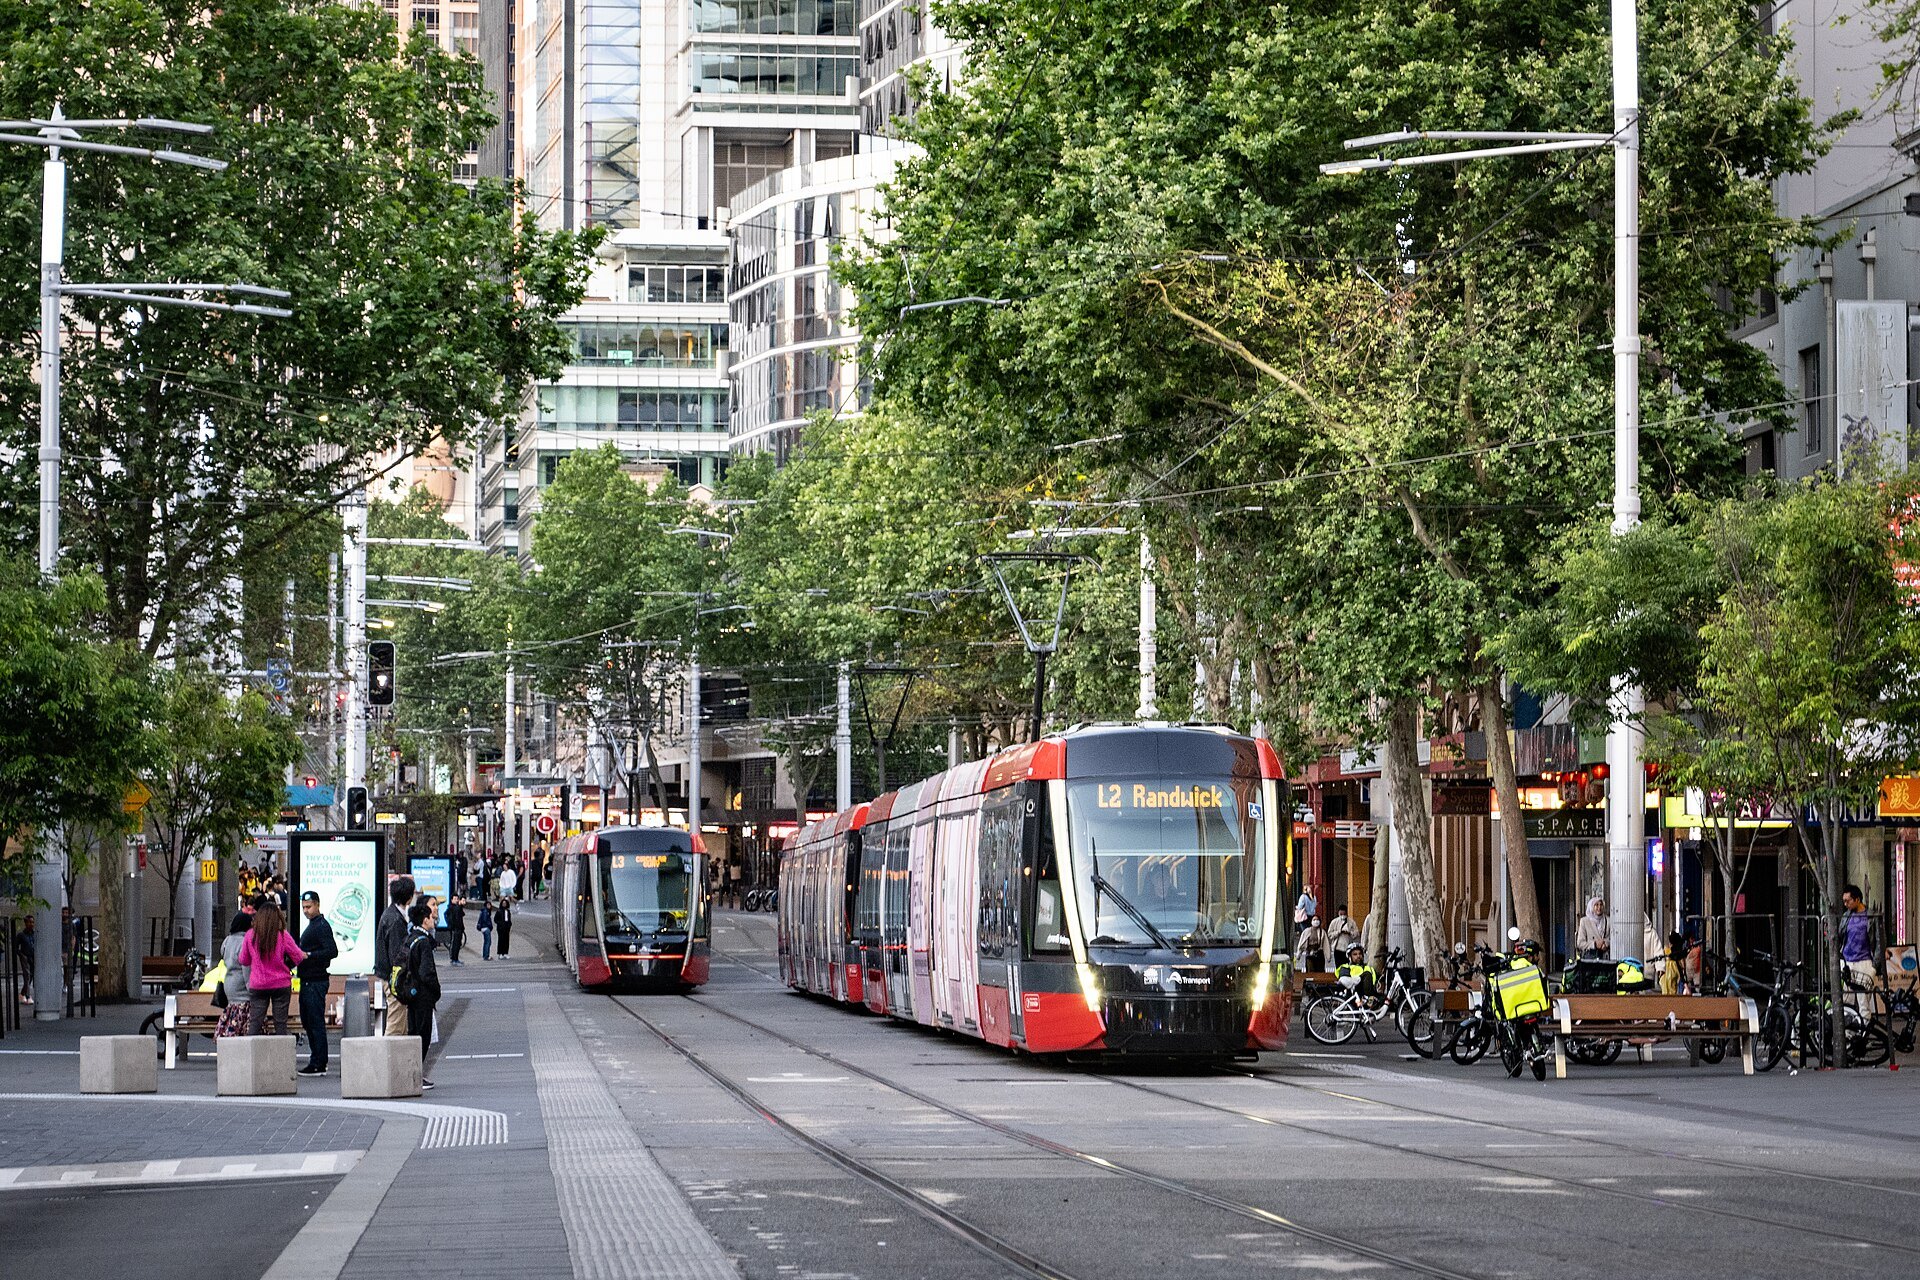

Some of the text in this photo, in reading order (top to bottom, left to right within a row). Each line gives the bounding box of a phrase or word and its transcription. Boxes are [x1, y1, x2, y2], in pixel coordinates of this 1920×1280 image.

[1098, 784, 1223, 808] L2 Randwick
[542, 818, 550, 830] L
[1295, 826, 1336, 835] PHAACY
[1353, 822, 1364, 837] 7
[1537, 818, 1603, 831] SPACE
[612, 855, 625, 869] L3
[204, 863, 215, 877] 10
[1237, 916, 1257, 933] 56
[1182, 976, 1211, 985] Transport
